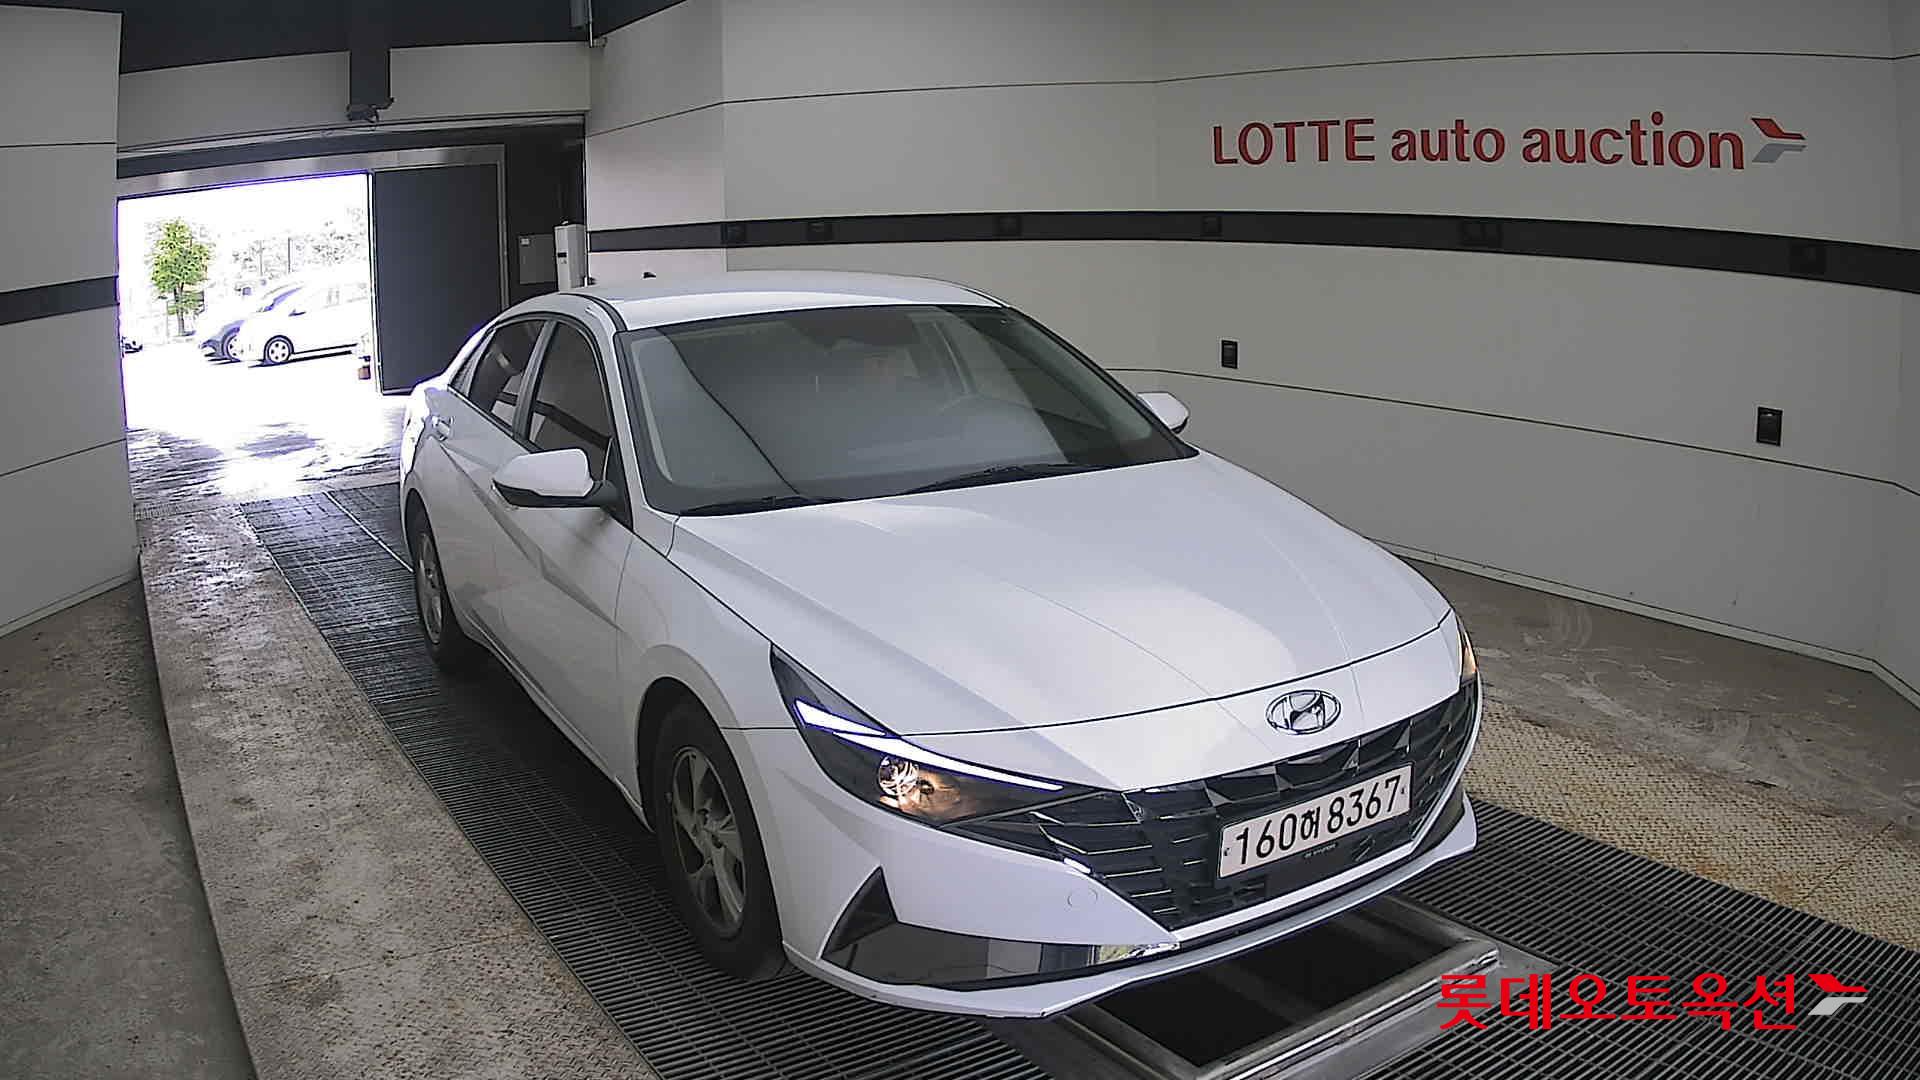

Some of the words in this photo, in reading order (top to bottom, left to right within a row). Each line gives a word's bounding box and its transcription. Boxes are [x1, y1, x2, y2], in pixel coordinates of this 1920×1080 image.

[1212, 118, 1376, 165] LOTTE
[1391, 119, 1506, 162] auto
[1521, 111, 1746, 170] auction
